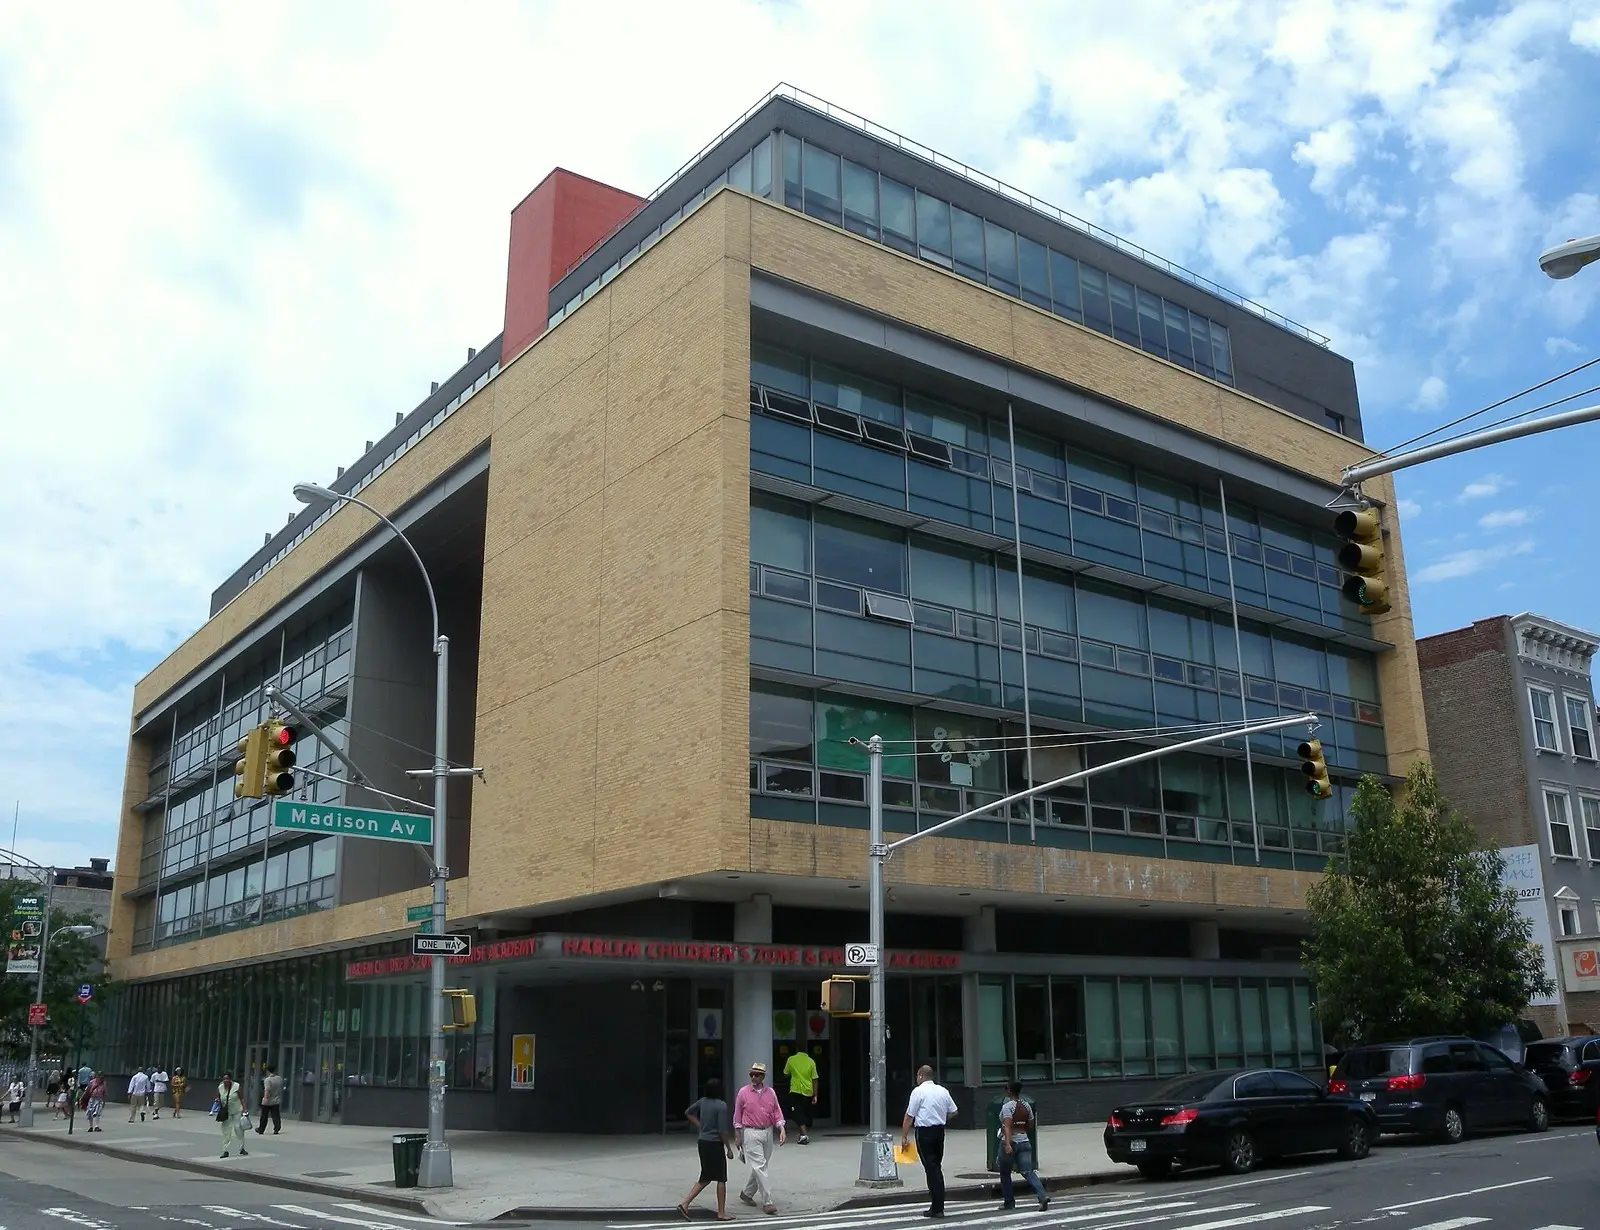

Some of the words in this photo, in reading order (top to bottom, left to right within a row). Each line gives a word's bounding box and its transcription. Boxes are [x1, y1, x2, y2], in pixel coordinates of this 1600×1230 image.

[291, 808, 379, 832] Madison
[390, 819, 416, 836] Av
[1506, 852, 1533, 865] SHI
[346, 960, 373, 977] HARLEM
[375, 957, 415, 975] CHILDREN'S
[417, 955, 433, 970] ZON
[488, 938, 536, 960] ACADEMY
[421, 940, 438, 949] ONE
[444, 941, 462, 950] WAY
[563, 936, 641, 958] HARLEM
[647, 940, 750, 962] CHILDREN'S
[753, 946, 800, 966] ZONE
[803, 949, 817, 965] &
[889, 950, 961, 967] ACADEMY
